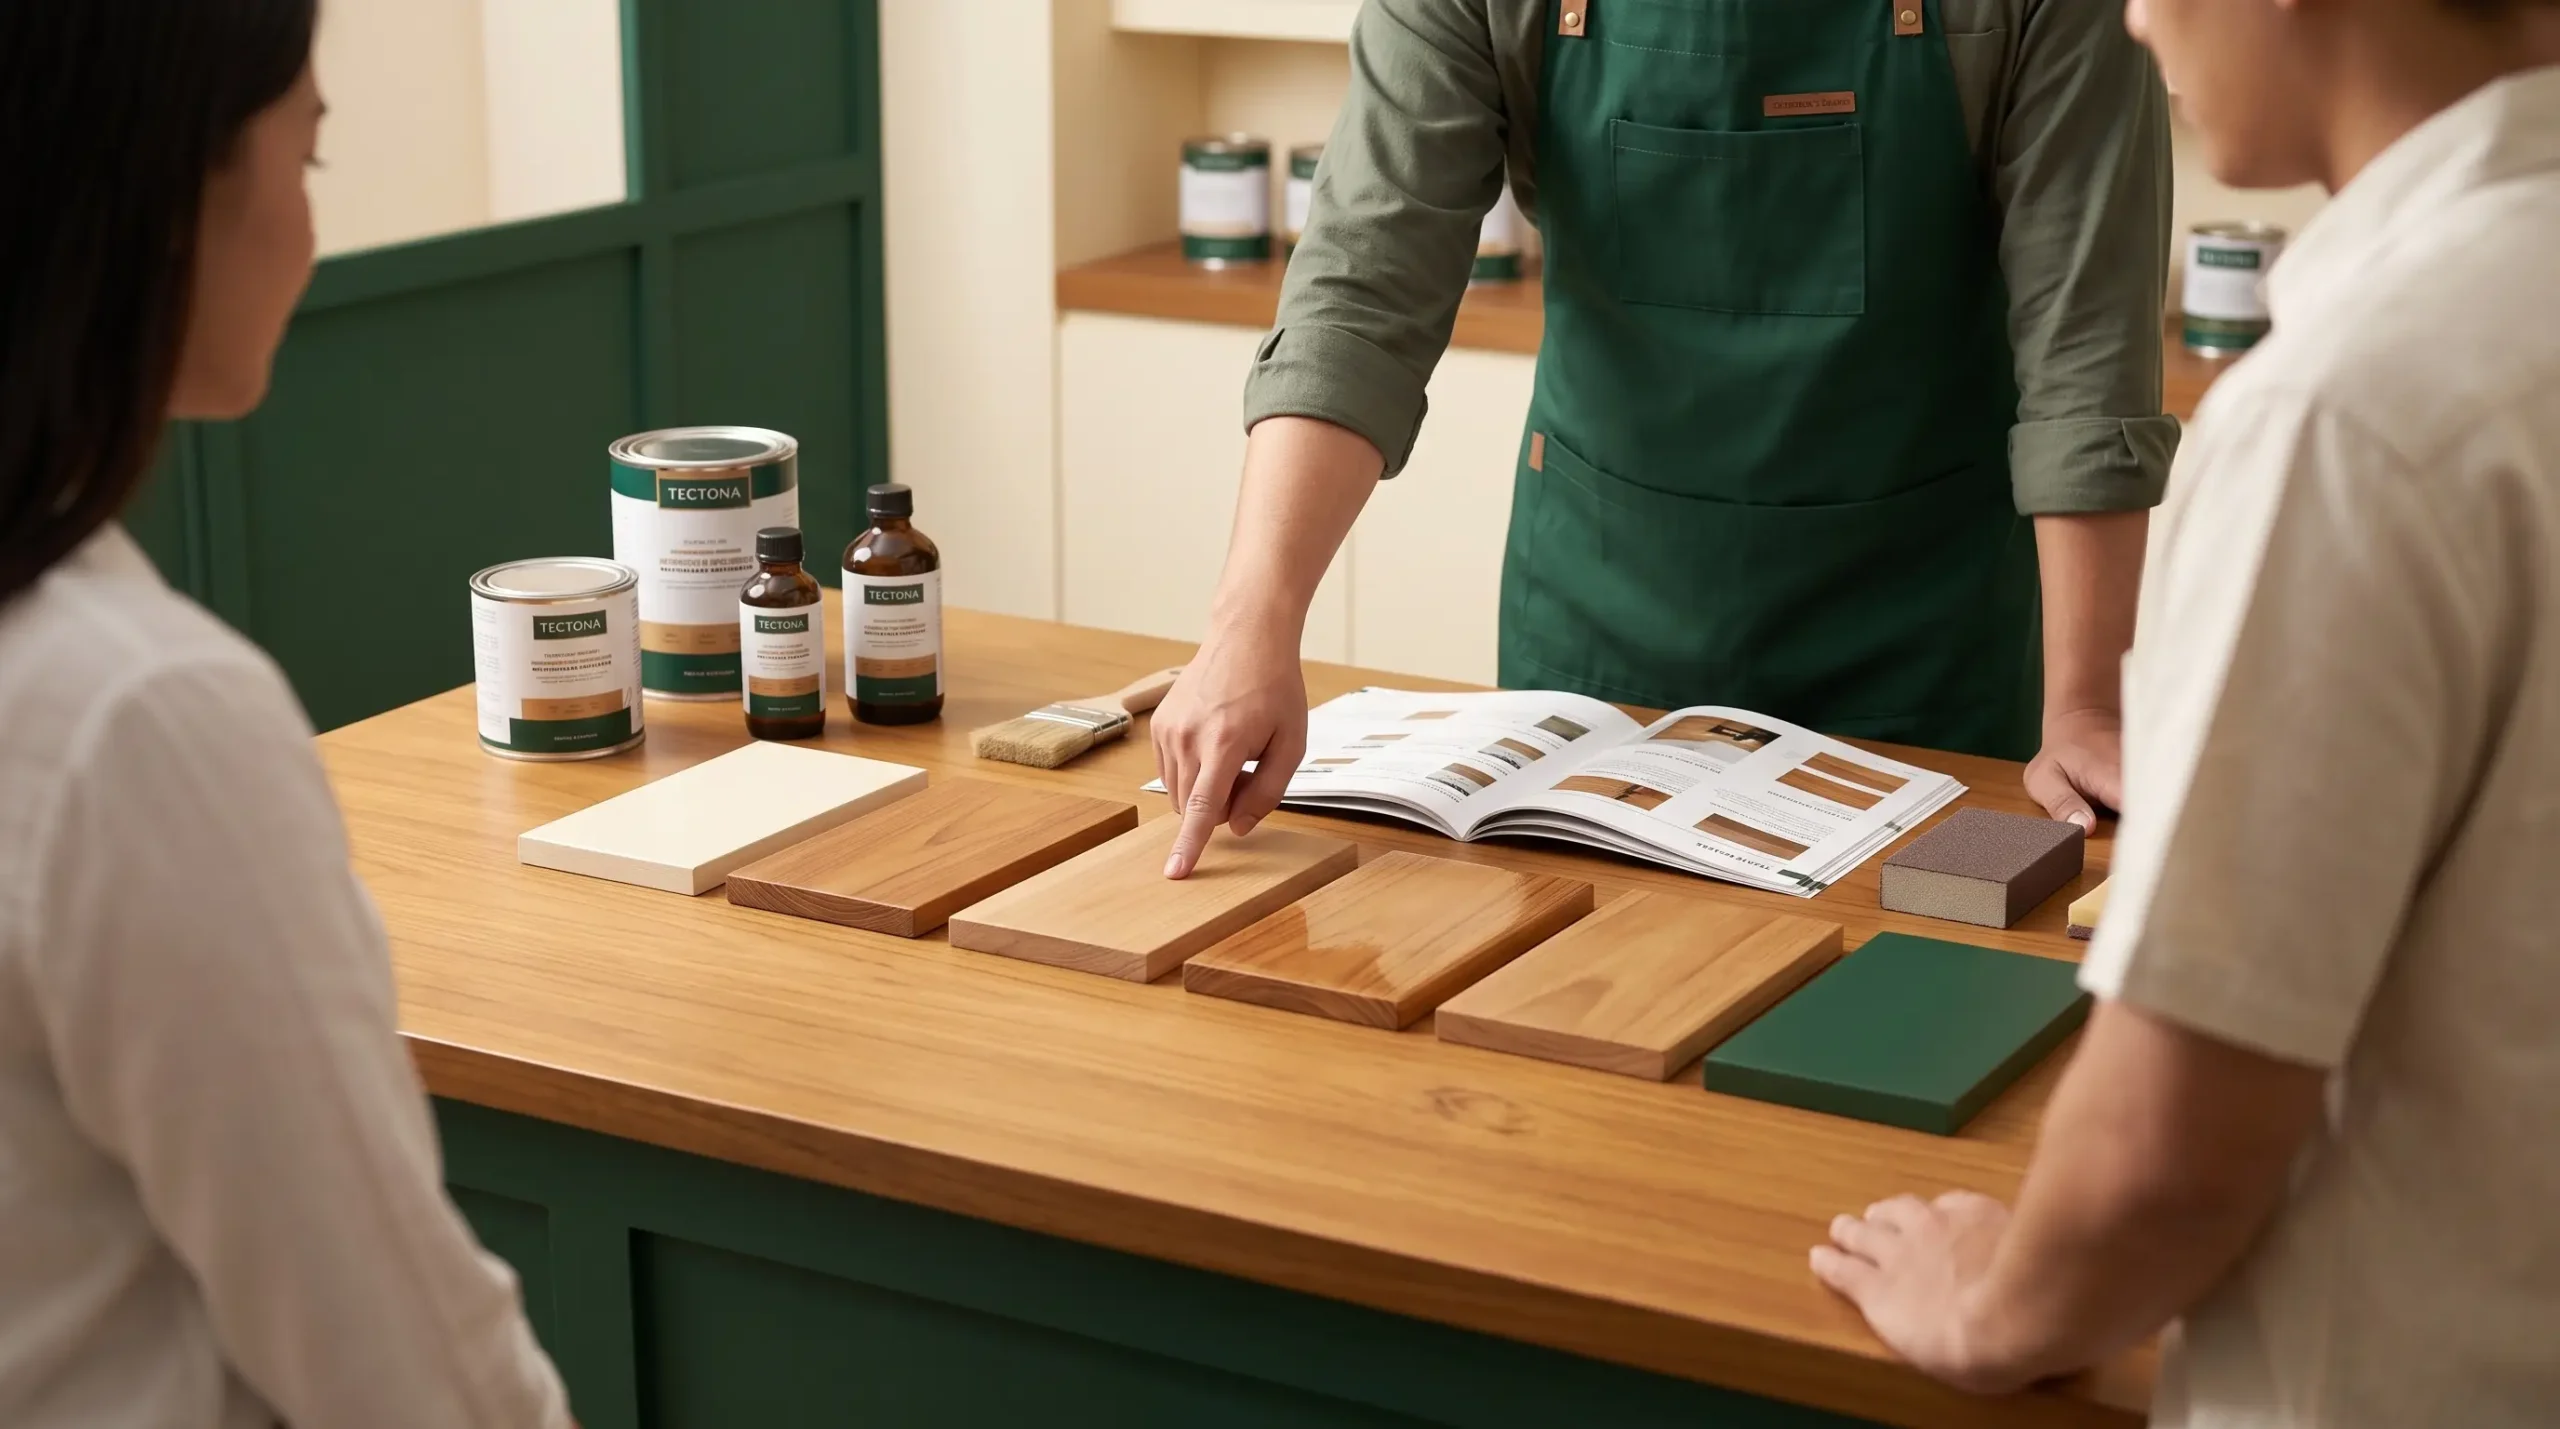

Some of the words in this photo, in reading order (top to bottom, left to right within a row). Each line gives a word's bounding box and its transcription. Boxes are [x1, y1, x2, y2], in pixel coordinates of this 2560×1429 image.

[668, 486, 741, 501] TECTONA
[869, 589, 919, 601] TECTONA
[540, 618, 601, 634] TECTONA
[758, 619, 805, 630] TECTONA
